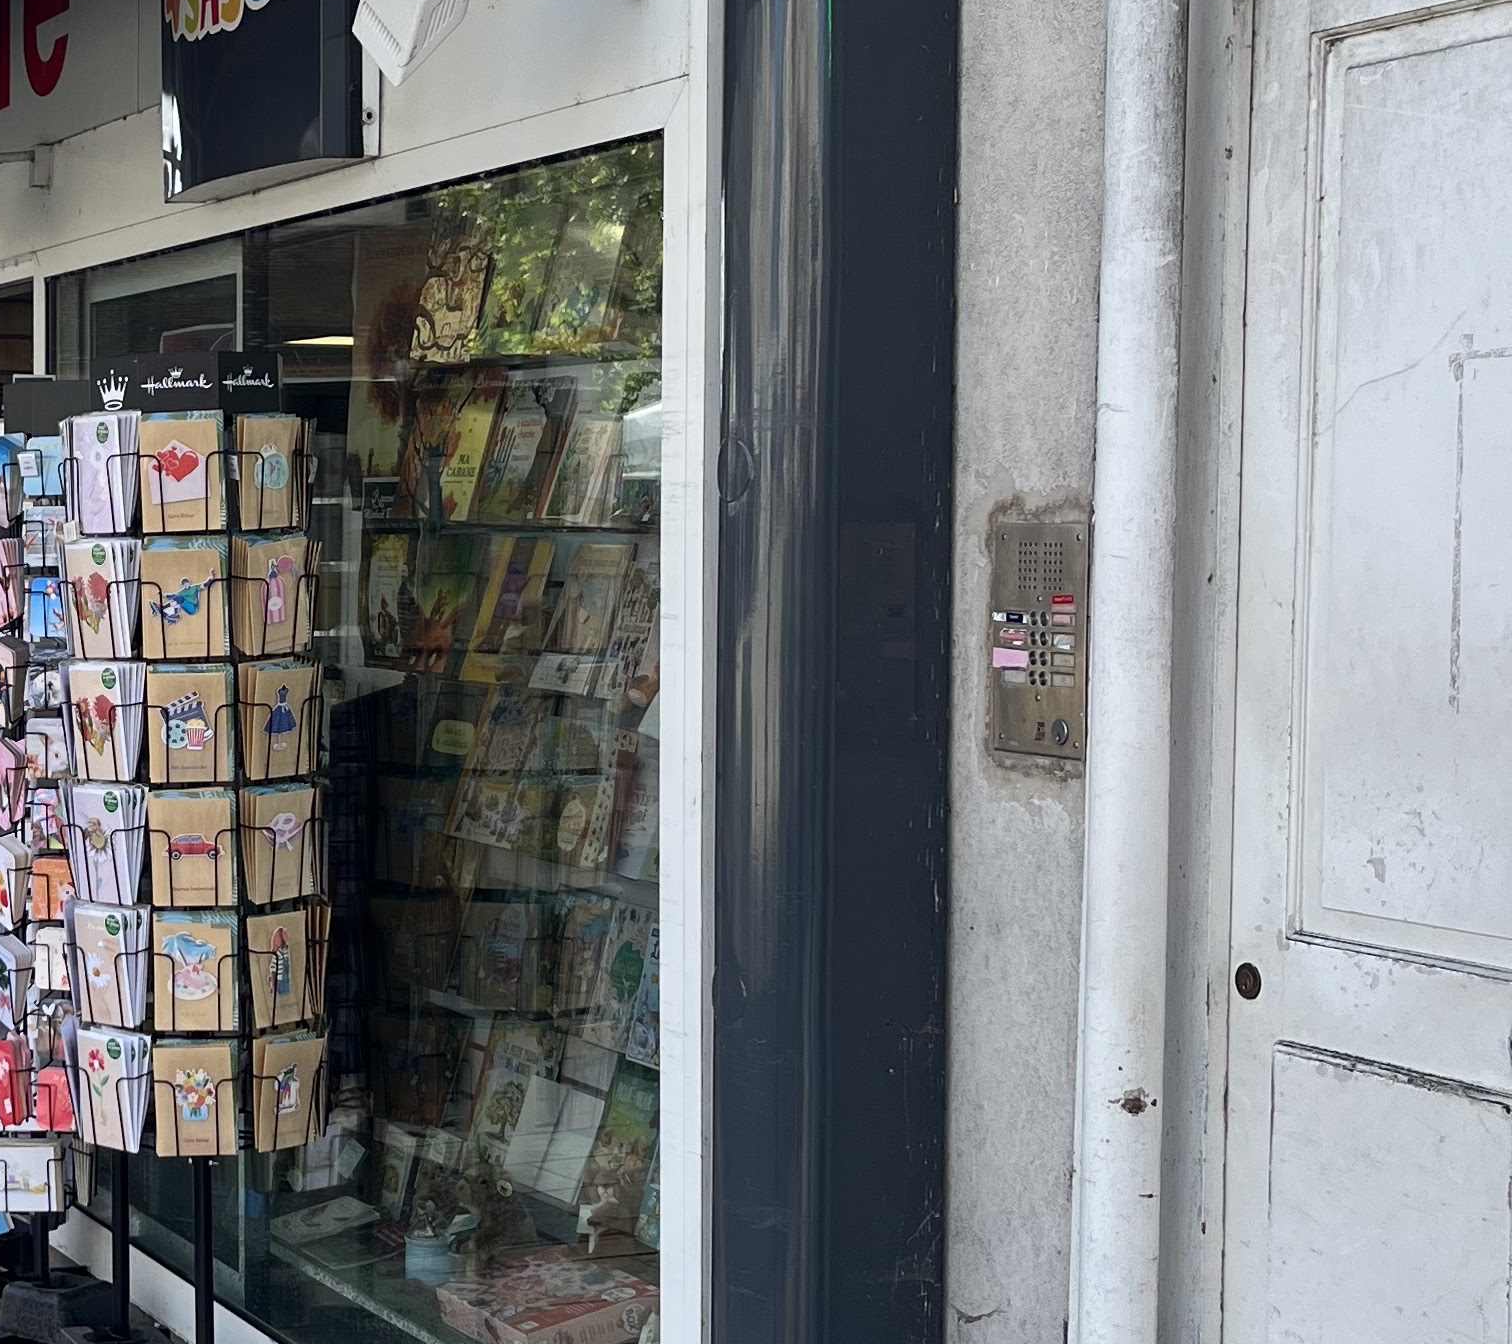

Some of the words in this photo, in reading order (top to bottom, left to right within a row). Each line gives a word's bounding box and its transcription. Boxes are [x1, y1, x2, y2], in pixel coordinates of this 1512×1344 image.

[141, 373, 213, 396] Hallmark
[222, 372, 275, 393] Hallmark
[457, 454, 470, 465] MA
